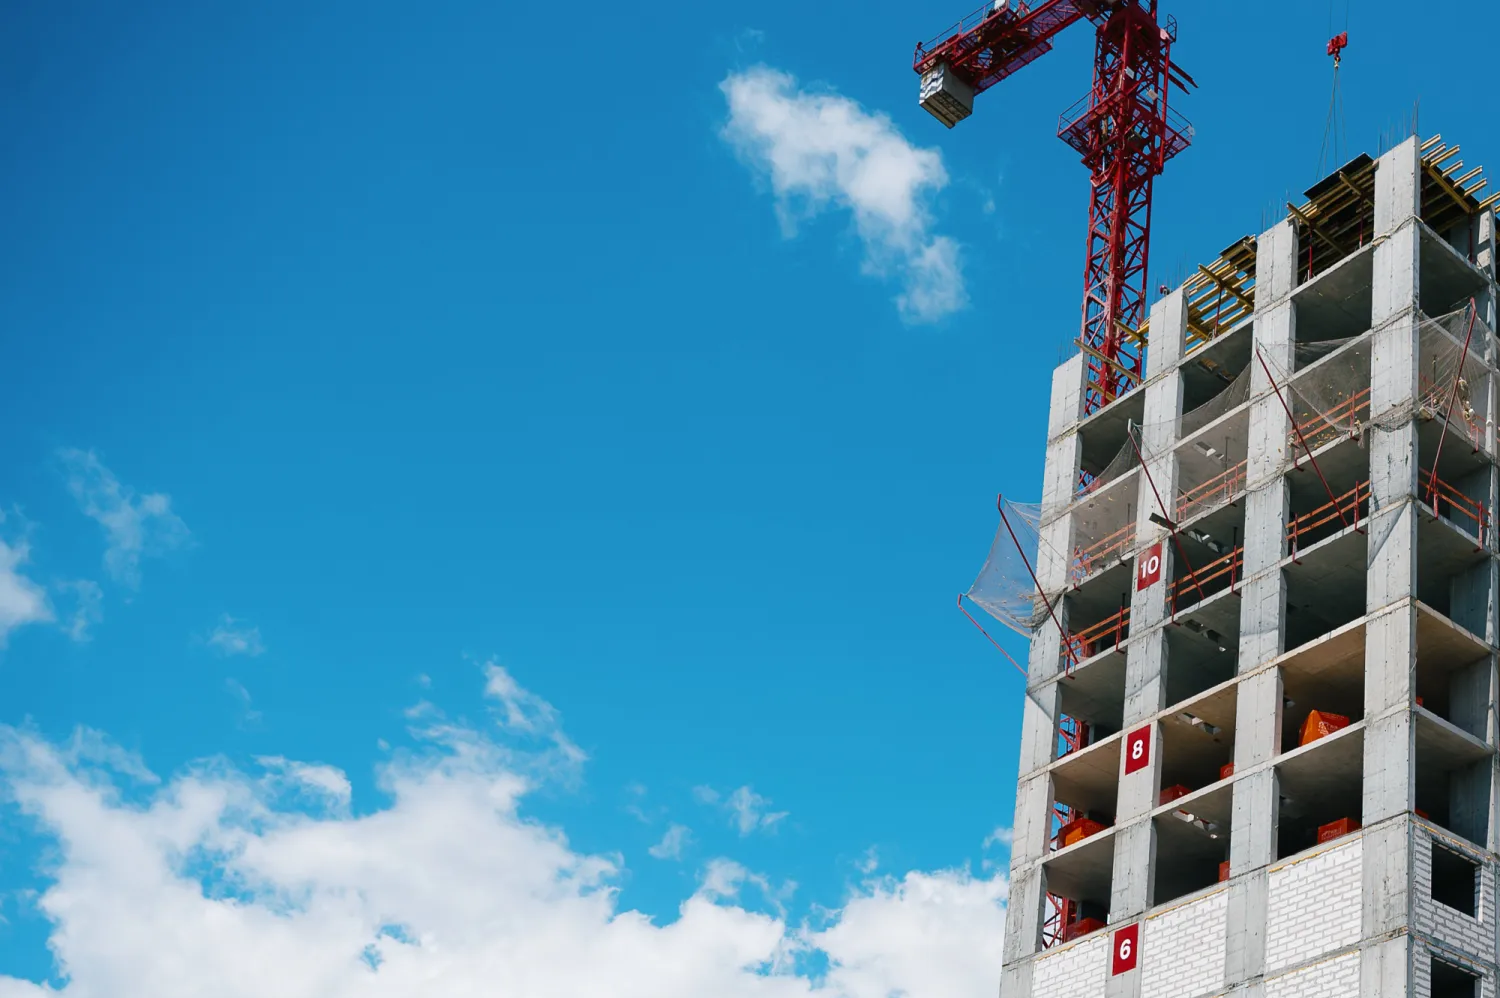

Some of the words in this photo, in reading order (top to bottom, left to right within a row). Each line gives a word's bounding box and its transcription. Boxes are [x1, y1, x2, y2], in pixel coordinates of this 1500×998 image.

[1141, 555, 1159, 578] 10
[1132, 740, 1143, 760] 8
[1120, 939, 1131, 960] 6
